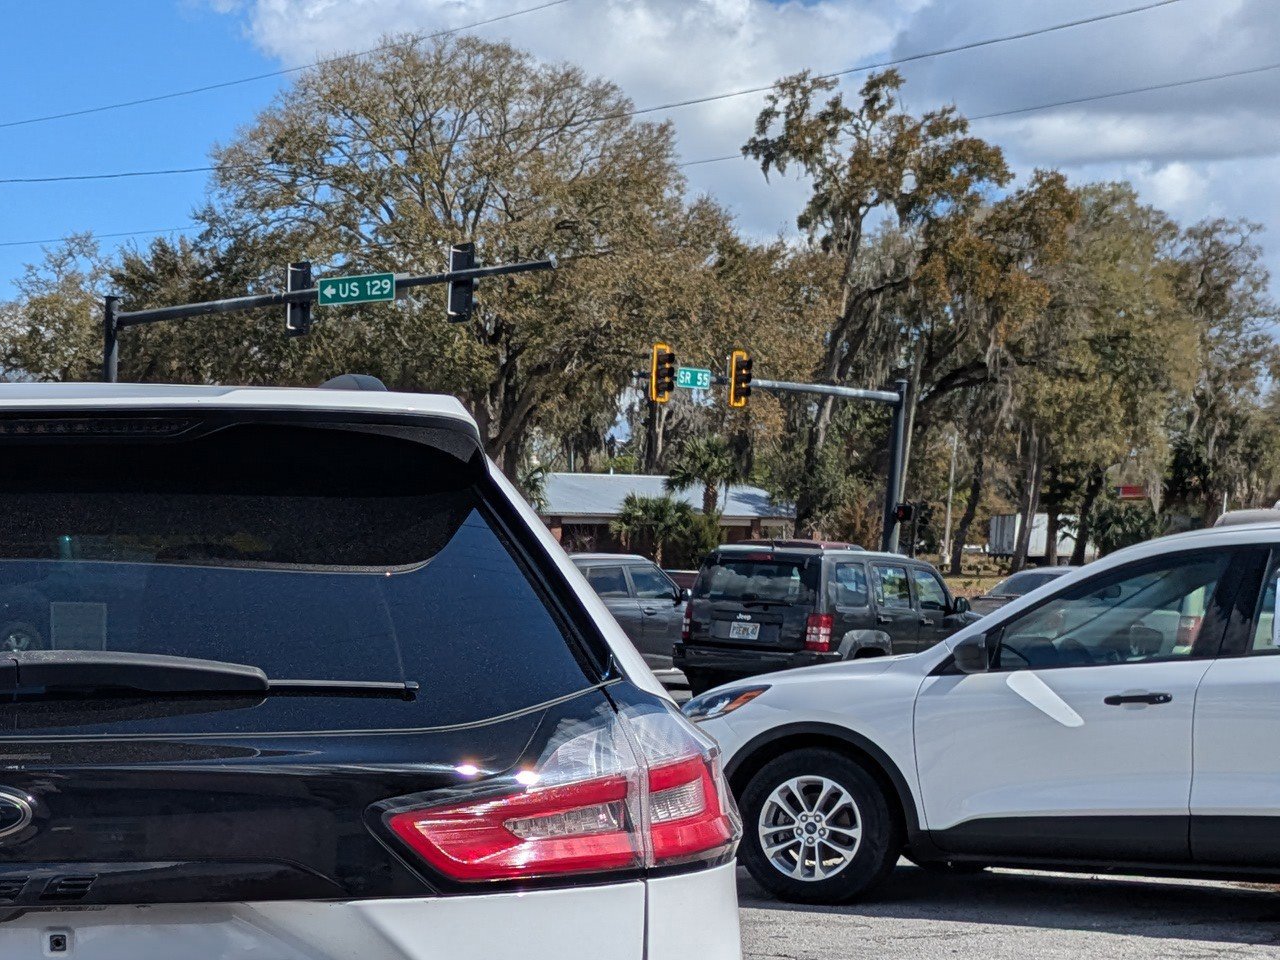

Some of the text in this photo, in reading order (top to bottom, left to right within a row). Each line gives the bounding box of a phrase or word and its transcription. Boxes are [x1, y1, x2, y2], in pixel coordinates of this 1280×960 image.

[338, 279, 391, 298] US 129
[679, 370, 709, 387] SR 55
[736, 613, 752, 621] Jeep
